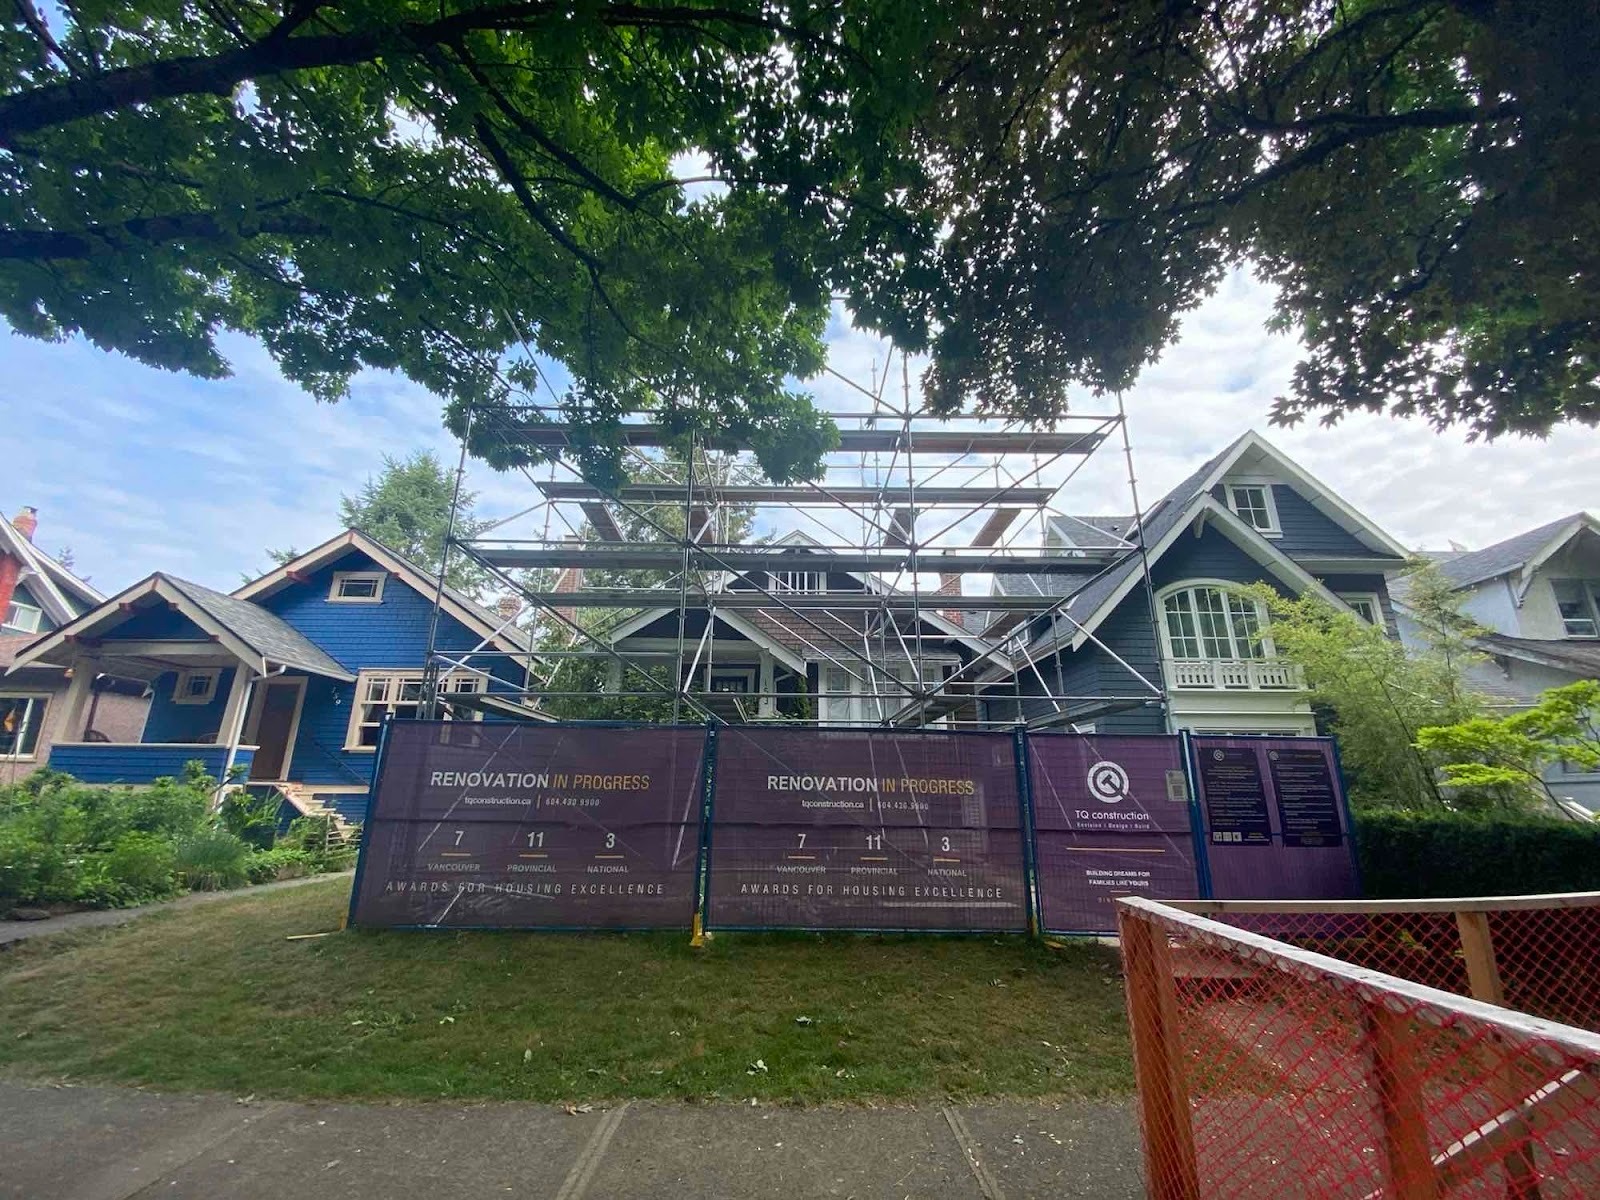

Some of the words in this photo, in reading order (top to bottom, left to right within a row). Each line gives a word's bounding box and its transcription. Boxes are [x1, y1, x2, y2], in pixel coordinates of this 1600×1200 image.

[430, 771, 549, 788] RENOVATION
[552, 775, 568, 789] IN
[572, 775, 650, 790] PROGRESS
[767, 775, 878, 792] RENOVATION
[881, 778, 896, 793] IN
[901, 778, 975, 795] PROGRESS
[464, 796, 532, 807] tqconstruction.ca
[801, 799, 865, 810] tqconstruction.ca
[1075, 810, 1089, 820] TQ
[1091, 811, 1149, 820] construction
[454, 830, 465, 847] 7
[526, 831, 544, 848] 11
[605, 832, 616, 849] 3
[797, 833, 807, 849] 7
[865, 834, 882, 850] 11
[941, 836, 950, 852] 3
[427, 863, 480, 872] VANCOUVER
[506, 864, 557, 873] PROVINCIAL
[587, 865, 629, 874] NATIONAL
[776, 865, 827, 874] VANCOUVER
[850, 867, 898, 875] PROVINCIAL
[928, 868, 967, 877] NATIONAL
[386, 882, 449, 892] AWARDS
[458, 882, 486, 893] FOR
[495, 883, 562, 894] HOUSING
[571, 884, 664, 895] EXCELLENCE
[740, 883, 799, 894] AWARDS
[808, 884, 834, 895] FOR
[843, 885, 905, 896] HOUSING
[915, 886, 1002, 898] EXCELLENCE
